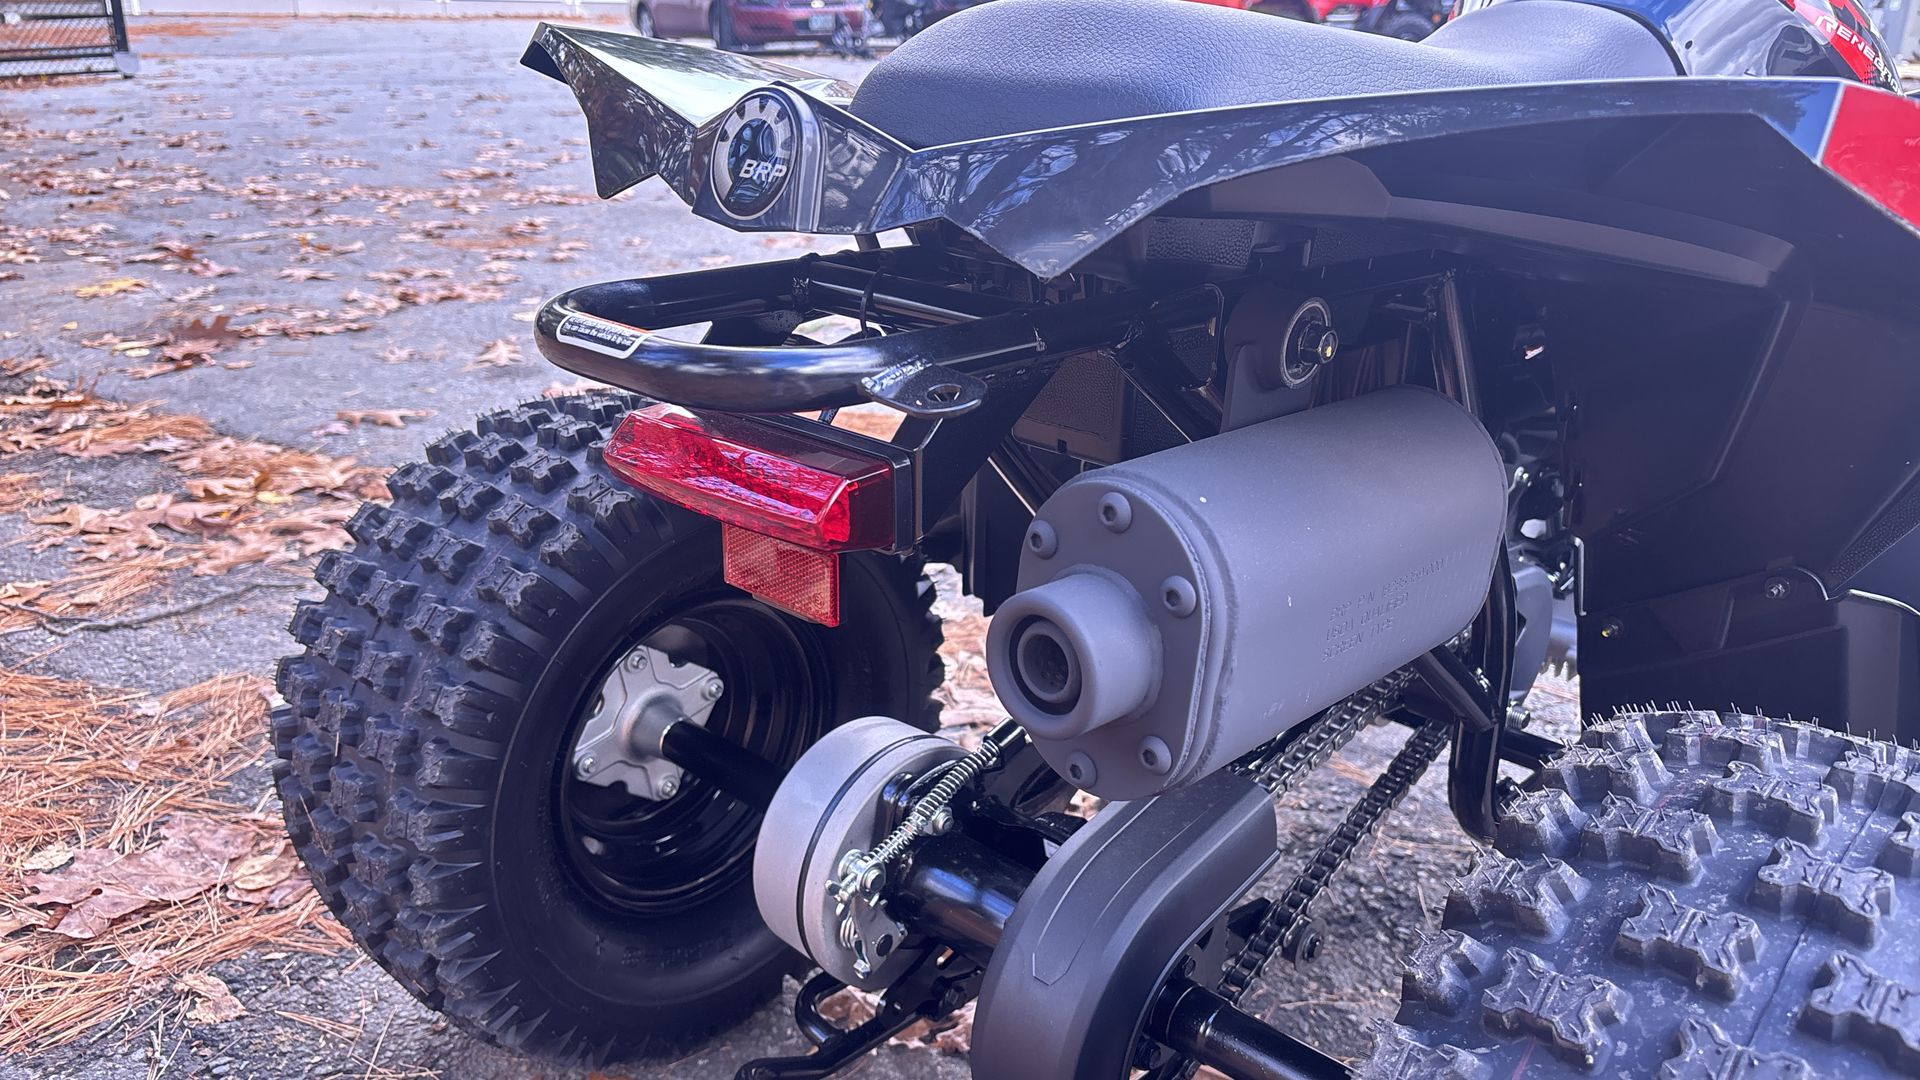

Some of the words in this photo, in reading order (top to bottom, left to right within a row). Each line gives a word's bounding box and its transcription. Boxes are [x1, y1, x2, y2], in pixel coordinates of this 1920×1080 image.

[1814, 15, 1901, 96] RENEGAD
[739, 158, 787, 182] BRP
[1328, 600, 1352, 622] BRP
[1322, 631, 1364, 663] SCREEN
